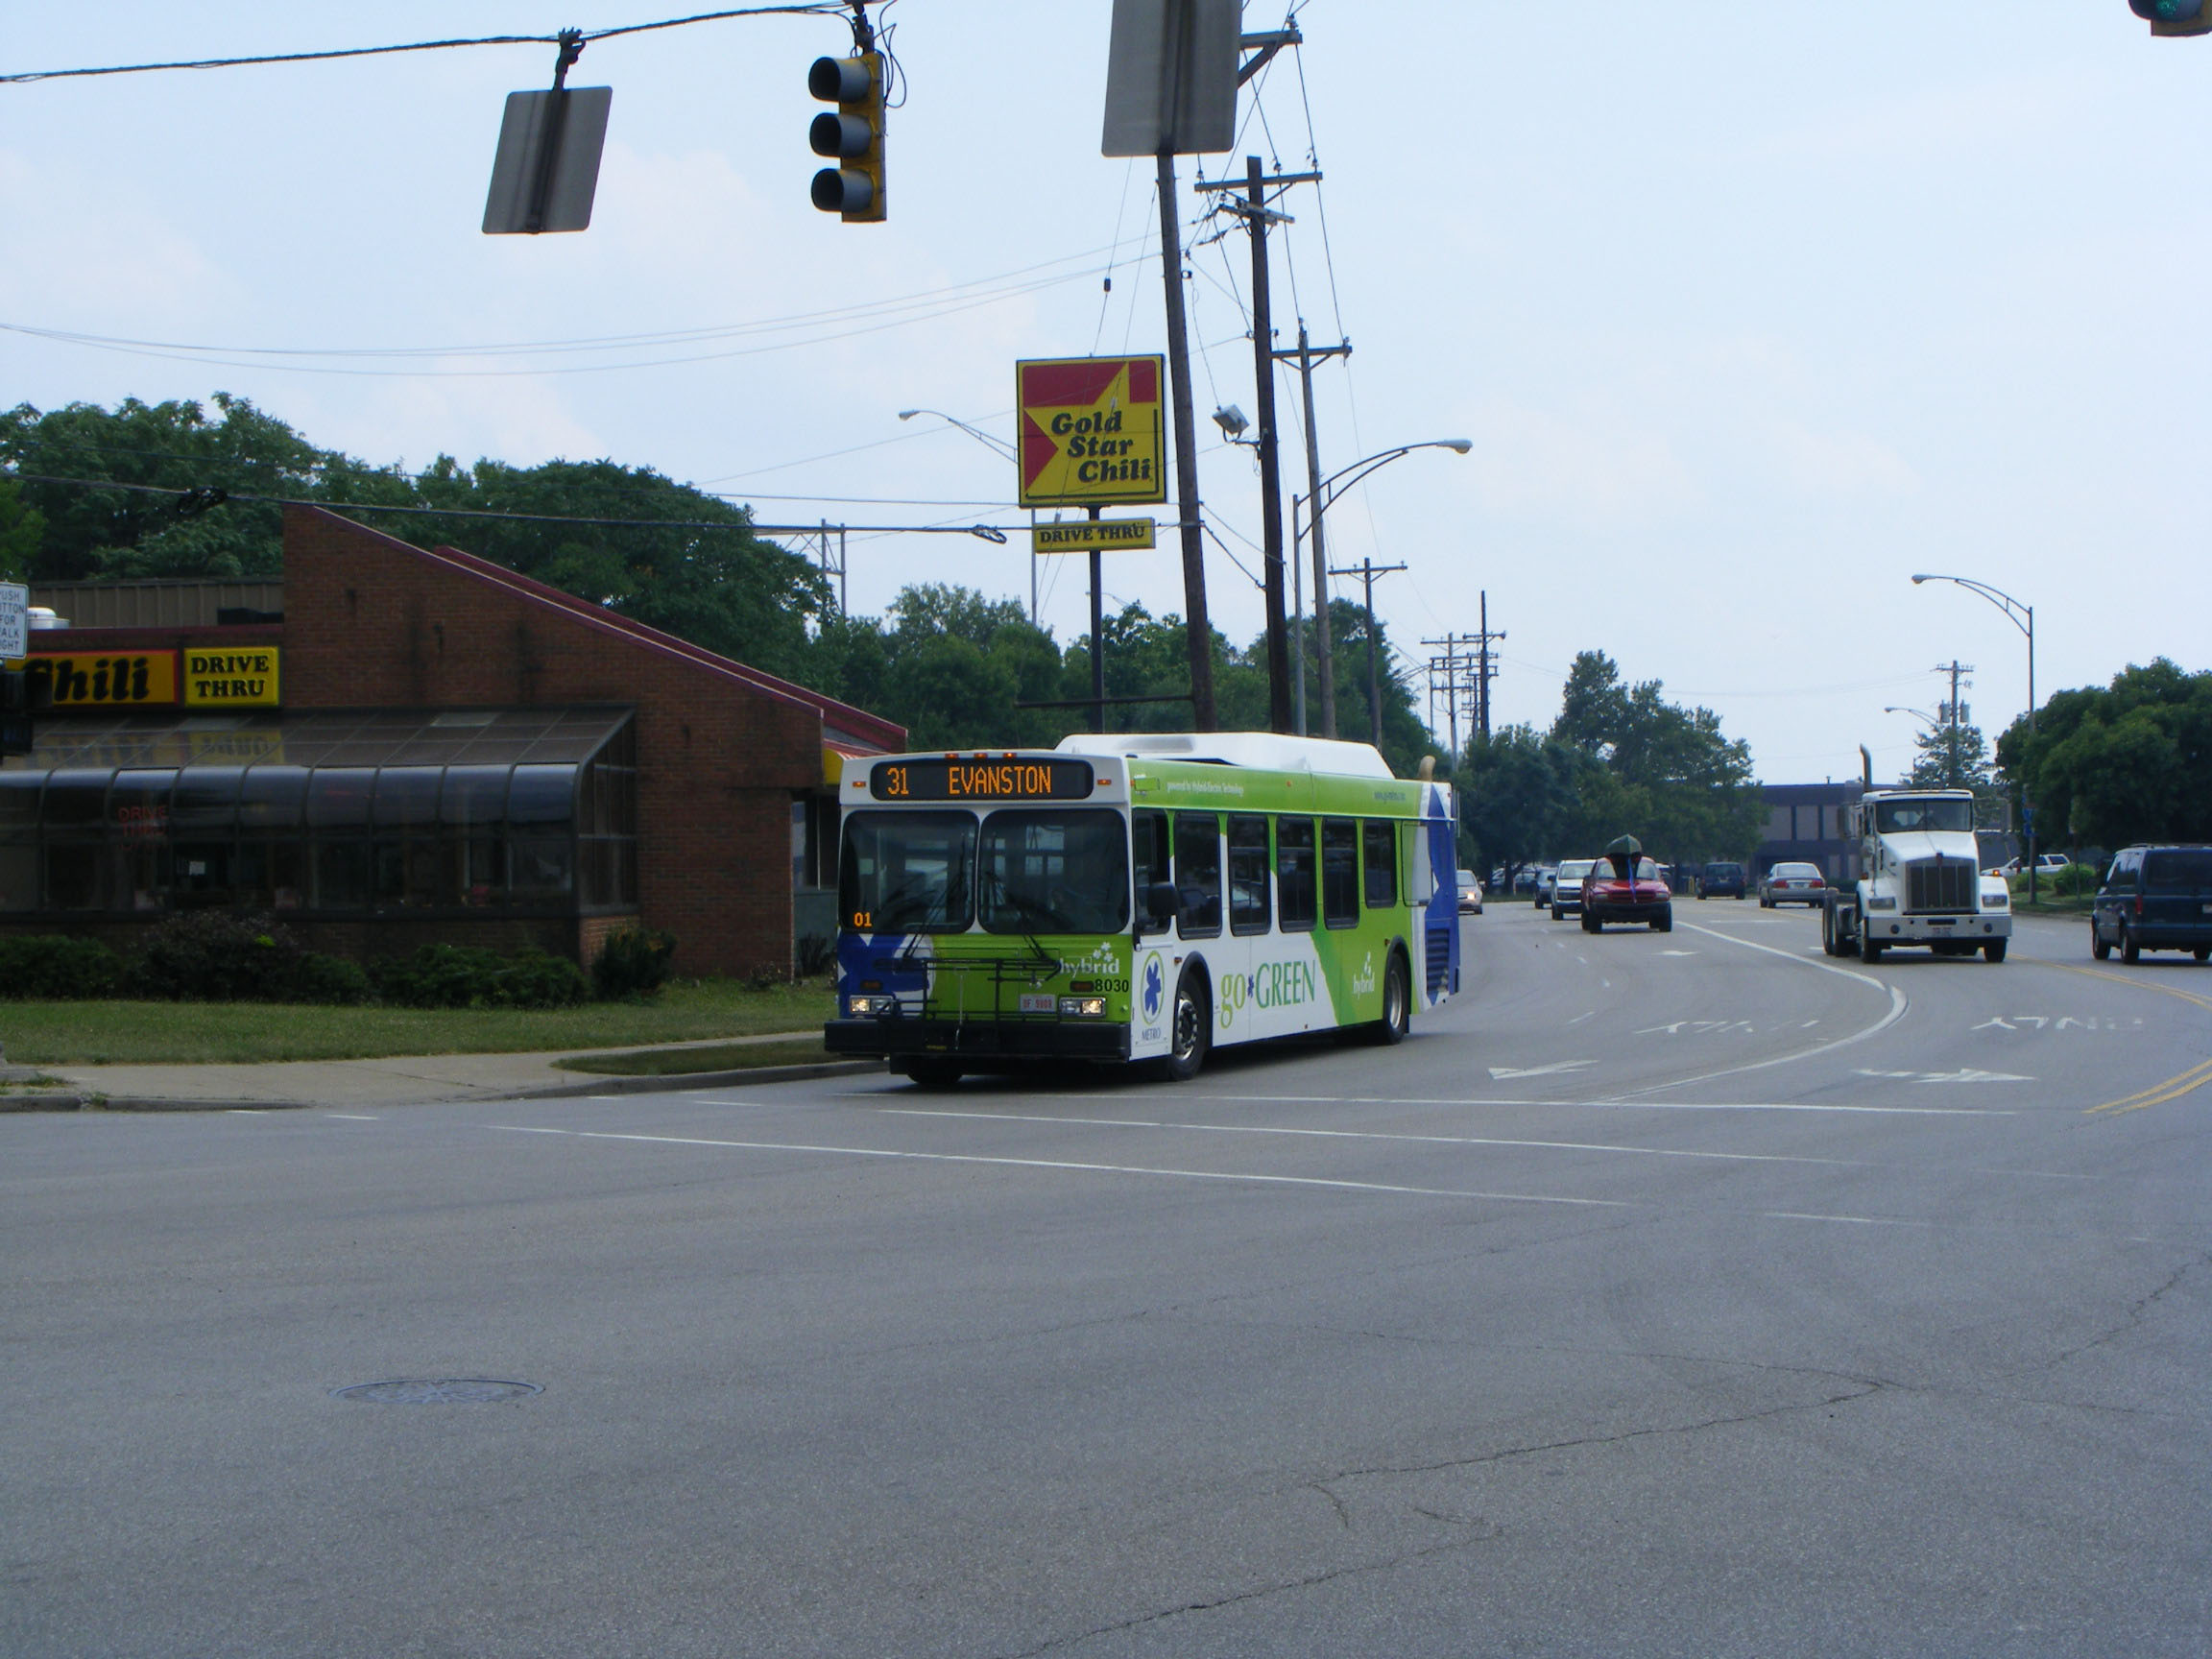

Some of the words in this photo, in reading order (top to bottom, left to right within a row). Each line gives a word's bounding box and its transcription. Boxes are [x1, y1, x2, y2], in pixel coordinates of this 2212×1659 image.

[1051, 410, 1122, 436] Gold
[1068, 435, 1134, 458] Star
[1077, 458, 1151, 483] Chili
[1040, 528, 1094, 543] DRIVE
[1096, 524, 1145, 541] THRU
[0, 628, 20, 639] ALK
[191, 655, 269, 675] DRIVE
[195, 679, 265, 698] THRU
[886, 767, 910, 796] 31
[948, 765, 1052, 796] EVANSTON
[853, 911, 873, 928] 01
[1059, 957, 1120, 979] hybrid
[1094, 978, 1130, 994] 8030
[1219, 973, 1247, 1030] go
[1255, 959, 1316, 1009] GREEN
[1141, 1027, 1162, 1041] METRO
